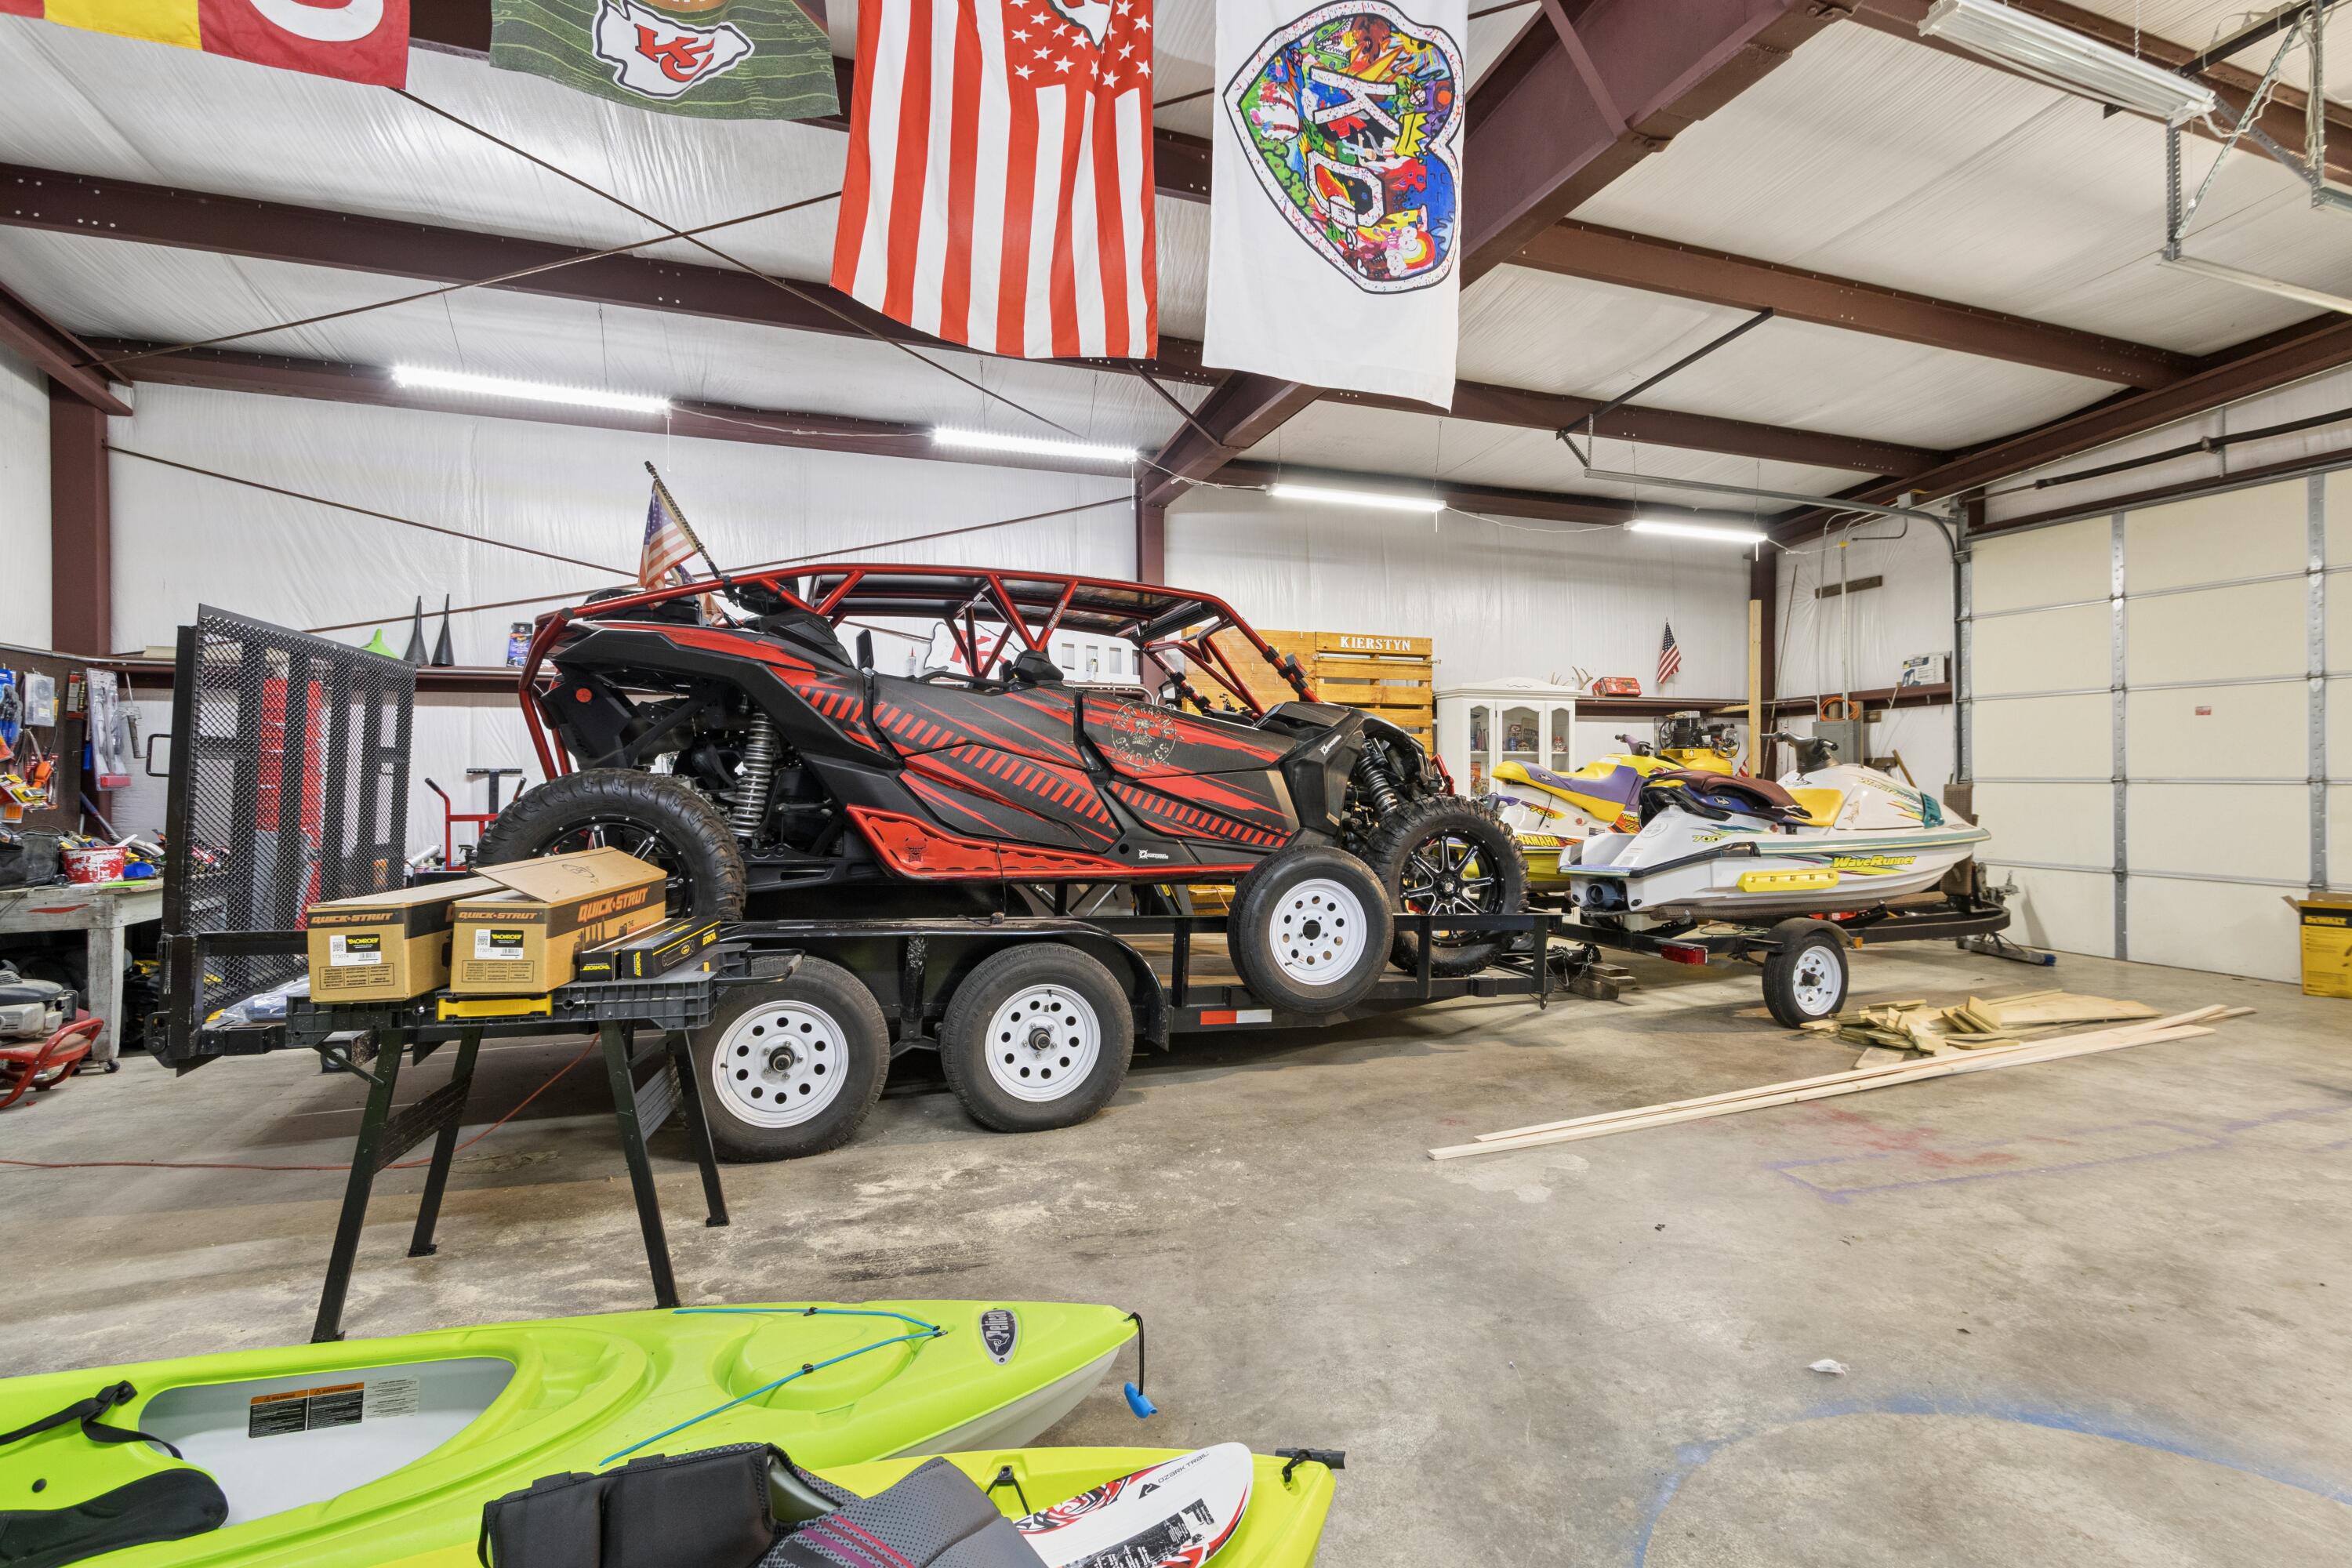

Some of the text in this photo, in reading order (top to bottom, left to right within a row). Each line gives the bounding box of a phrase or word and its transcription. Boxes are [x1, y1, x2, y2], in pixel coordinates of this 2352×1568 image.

[634, 24, 715, 82] KC
[1340, 636, 1410, 652] KIERSTYN
[1517, 833, 1560, 847] YAMAHA
[1833, 855, 1917, 868] WaveRunner
